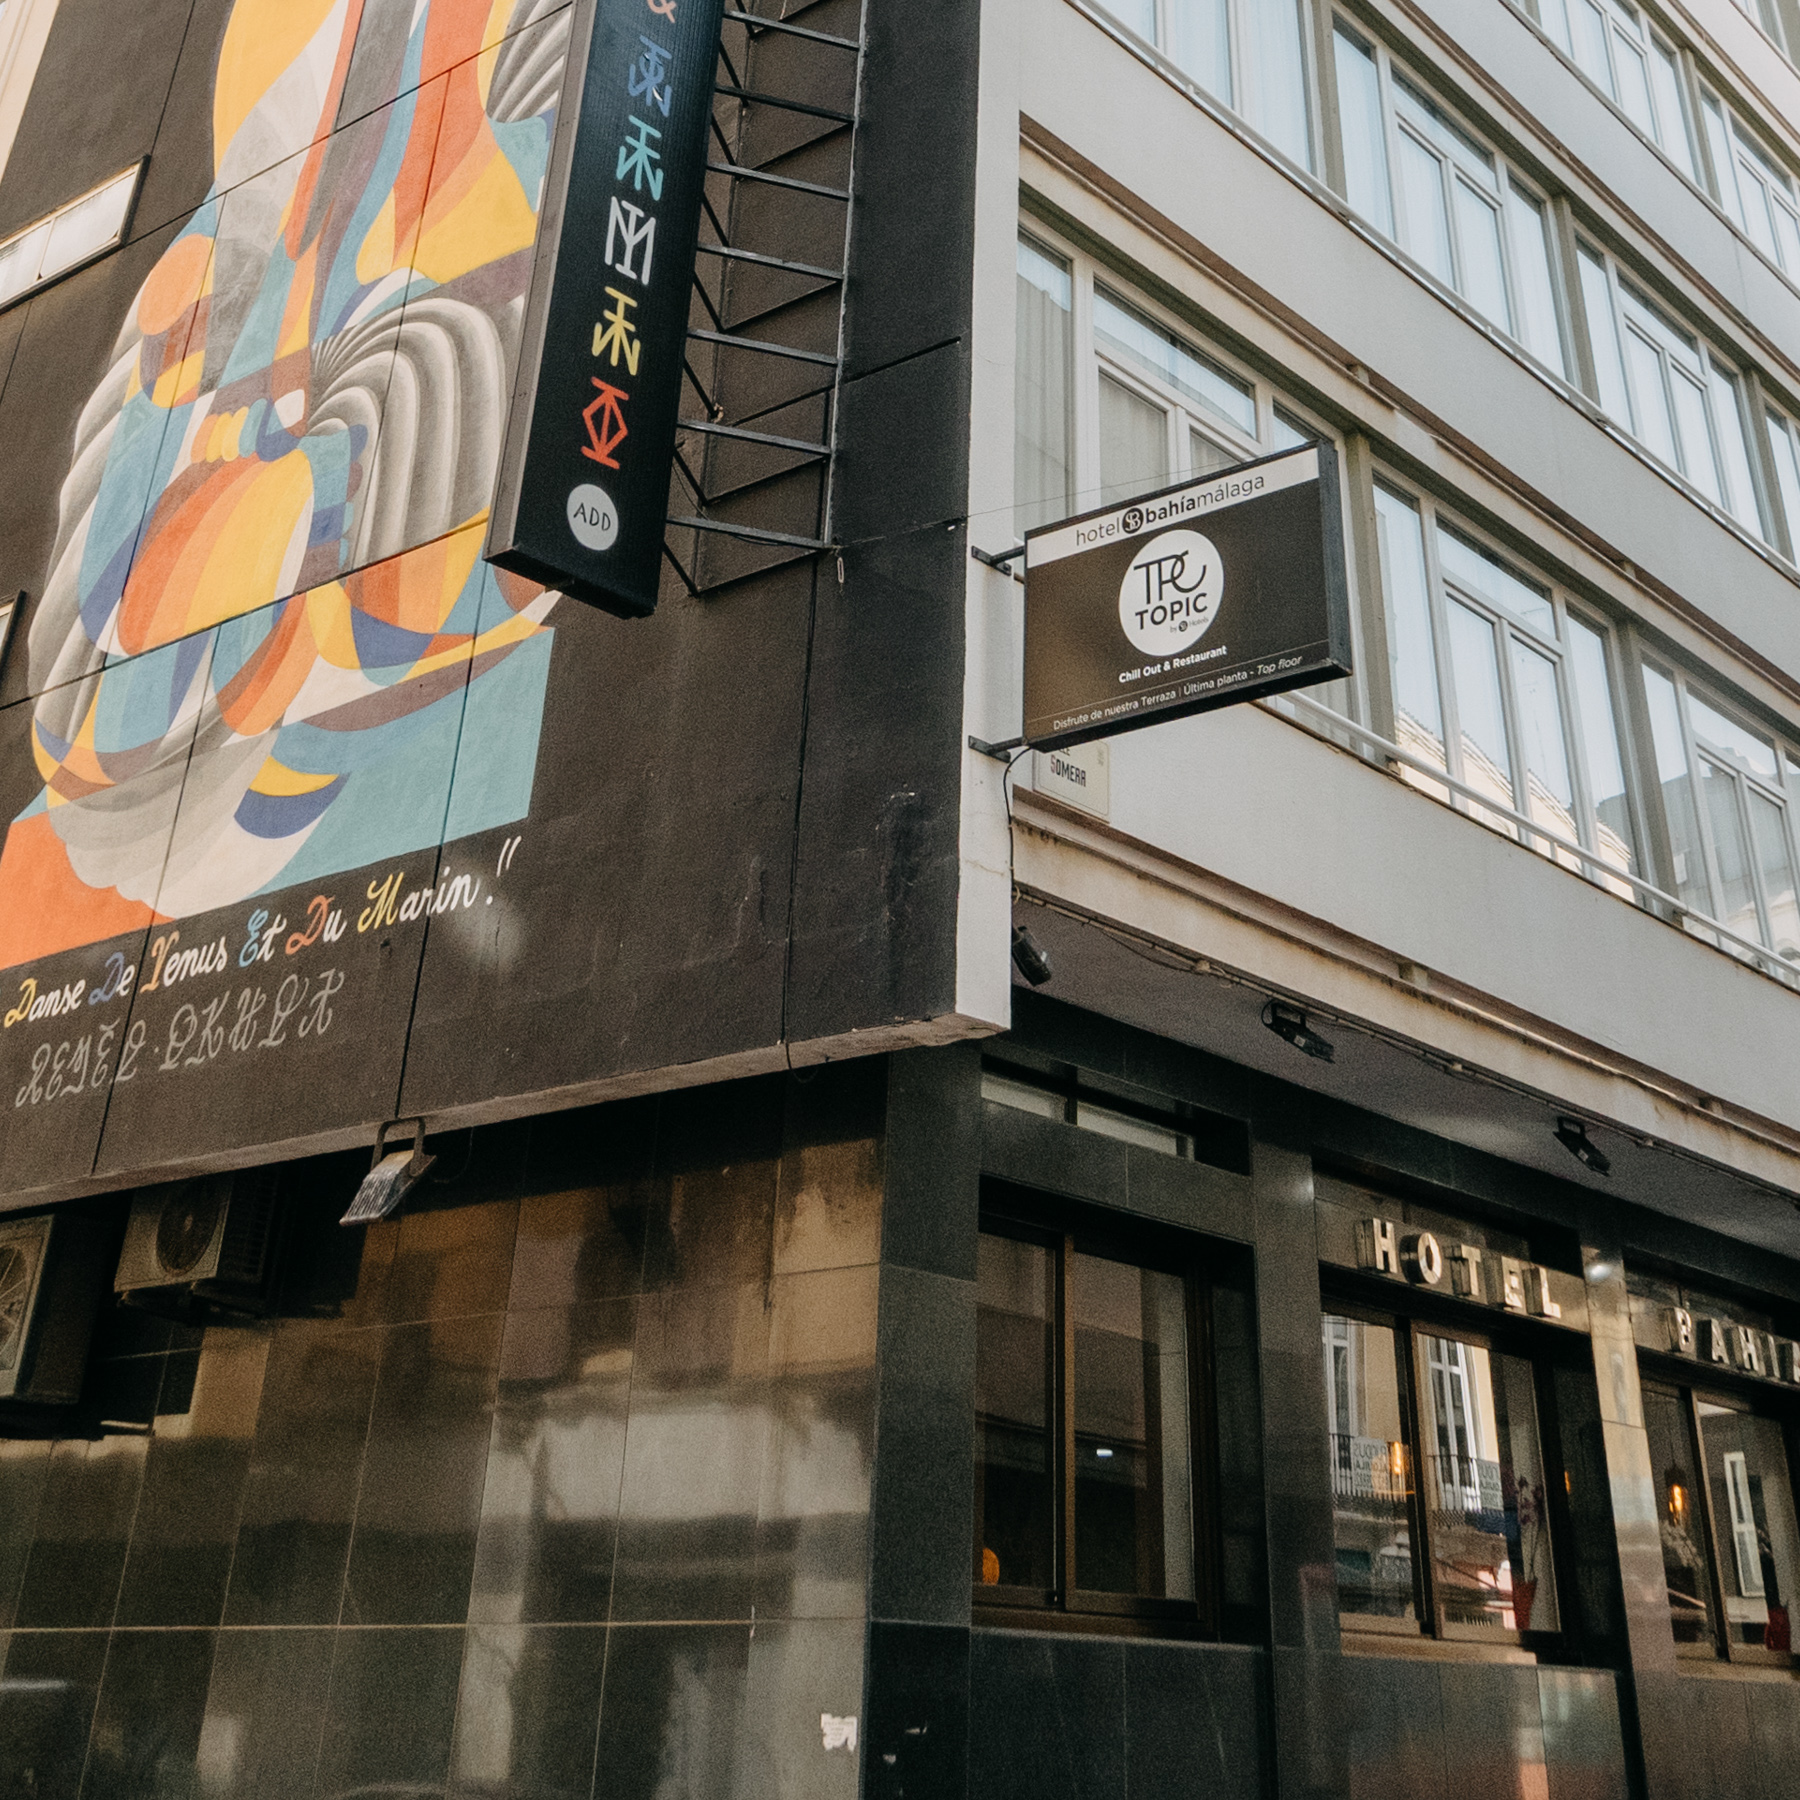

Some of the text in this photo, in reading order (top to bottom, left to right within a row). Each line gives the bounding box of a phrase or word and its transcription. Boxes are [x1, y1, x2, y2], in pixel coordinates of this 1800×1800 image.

[573, 502, 611, 532] ADD
[1075, 517, 1121, 547] hotel
[1135, 592, 1208, 630] TOPIC
[1118, 645, 1228, 684] Chill Out & Restaurant
[1053, 711, 1089, 731] Disfrute
[1090, 709, 1103, 720] de
[1104, 701, 1139, 717] nuestra
[1141, 690, 1177, 707] Terraza
[1183, 679, 1215, 697] Última
[1216, 671, 1248, 688] planta
[1256, 663, 1277, 678] Top
[1278, 655, 1303, 670] floor
[1050, 754, 1087, 788] SOMERA
[4, 977, 87, 1029] Danse
[88, 950, 136, 1006] De
[139, 930, 228, 995] Venus
[238, 907, 287, 968] Et
[284, 894, 348, 956] Du
[1370, 1217, 1562, 1320] HOTEL
